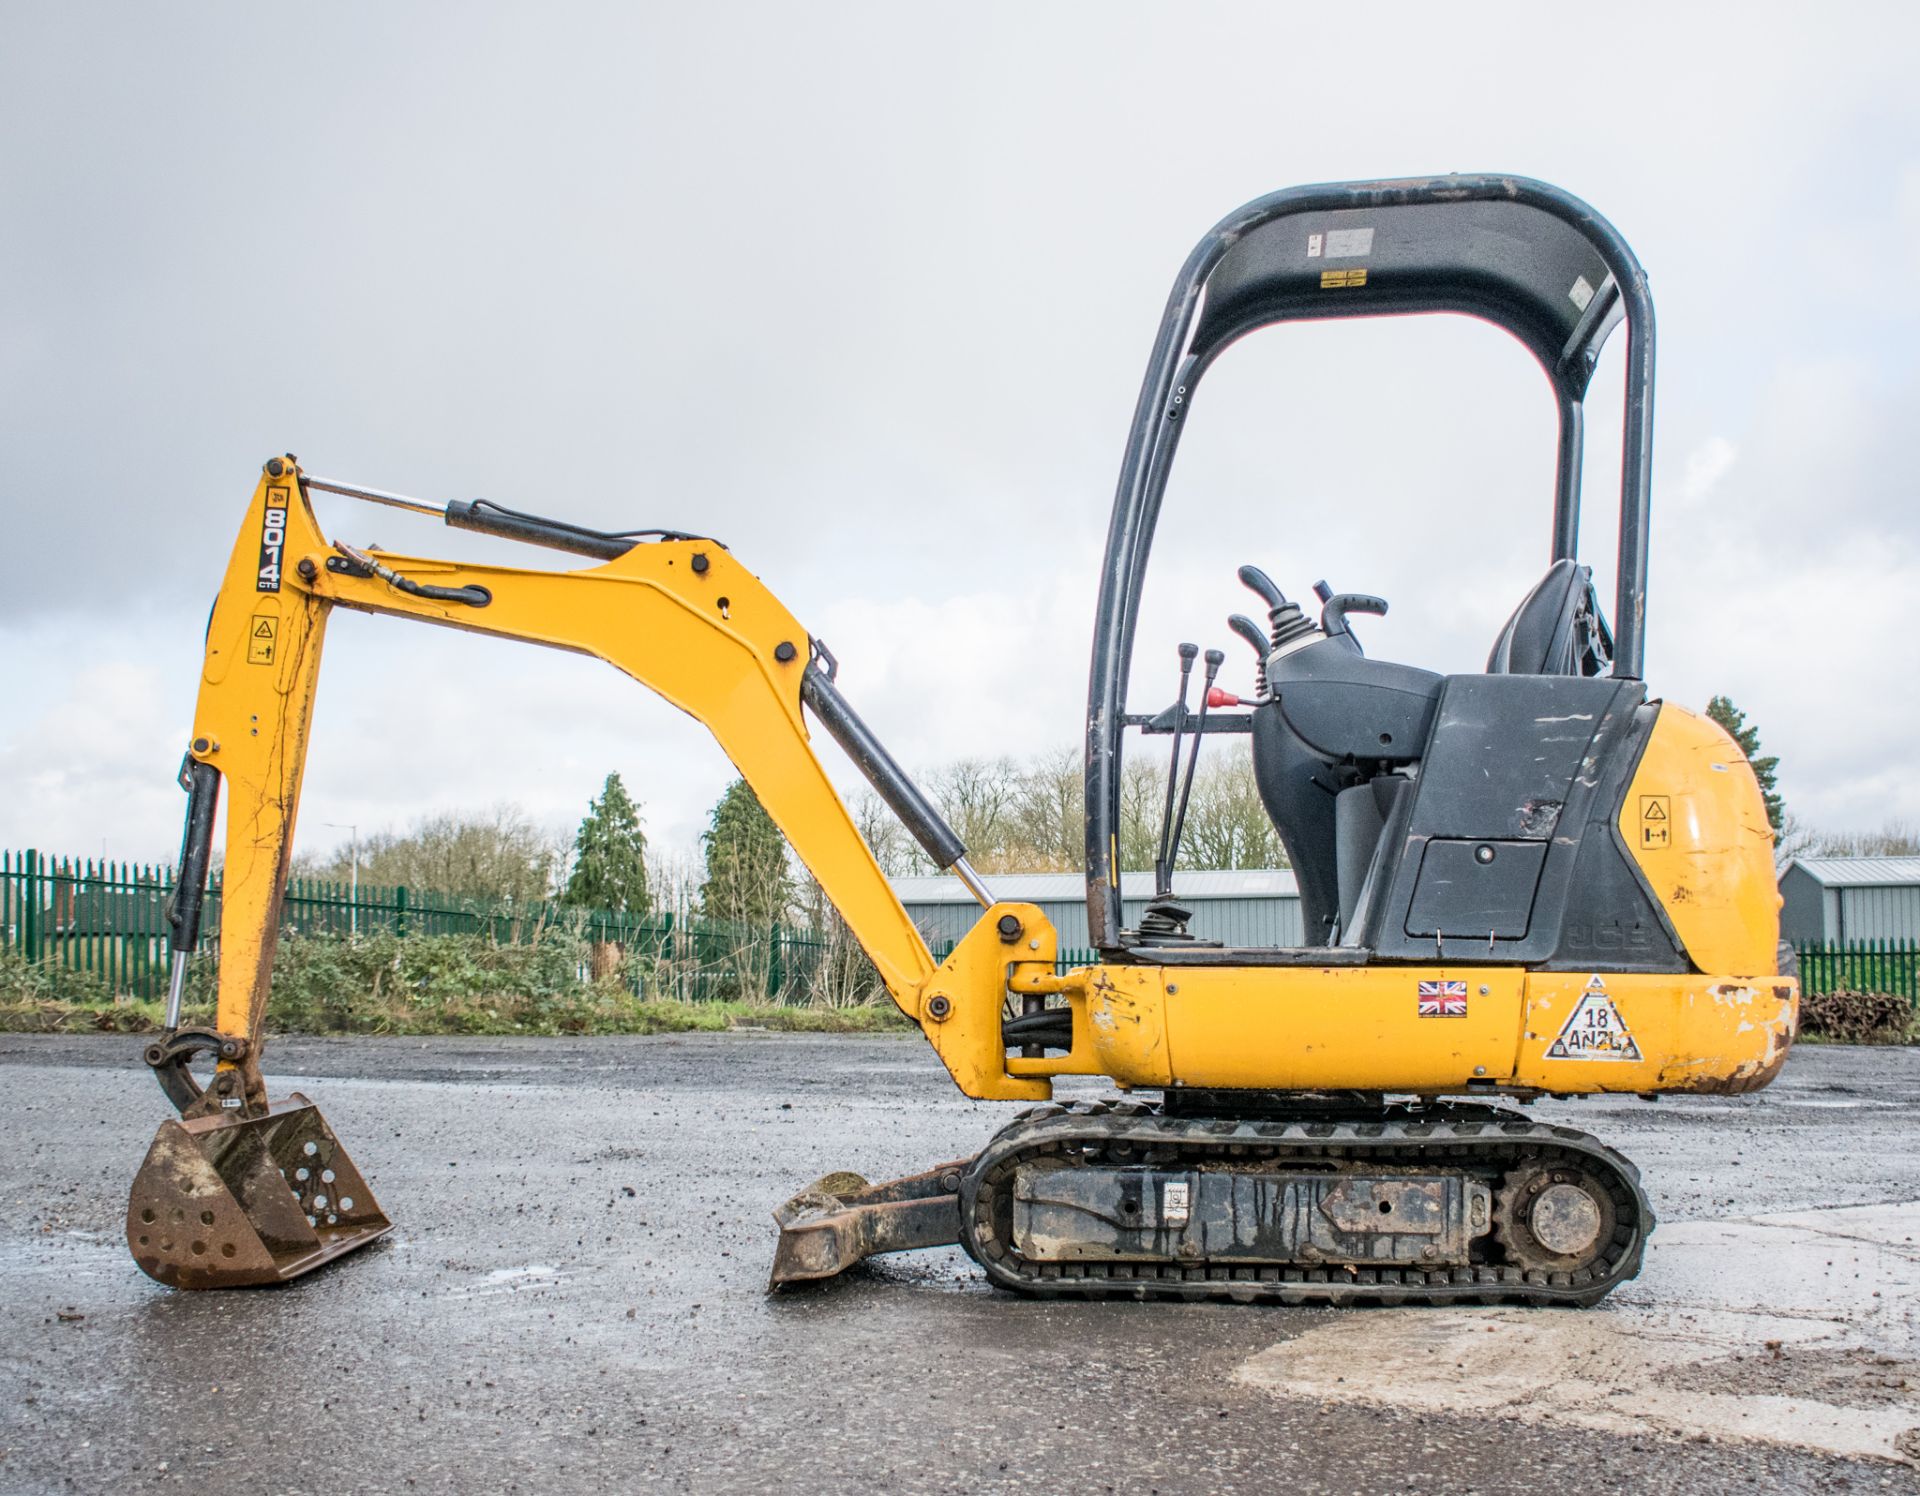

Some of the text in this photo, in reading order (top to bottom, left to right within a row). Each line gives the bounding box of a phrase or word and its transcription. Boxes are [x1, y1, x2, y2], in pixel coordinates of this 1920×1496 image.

[259, 509, 287, 583] 8014
[1568, 924, 1652, 950] JCB
[1585, 1008, 1609, 1029] 18
